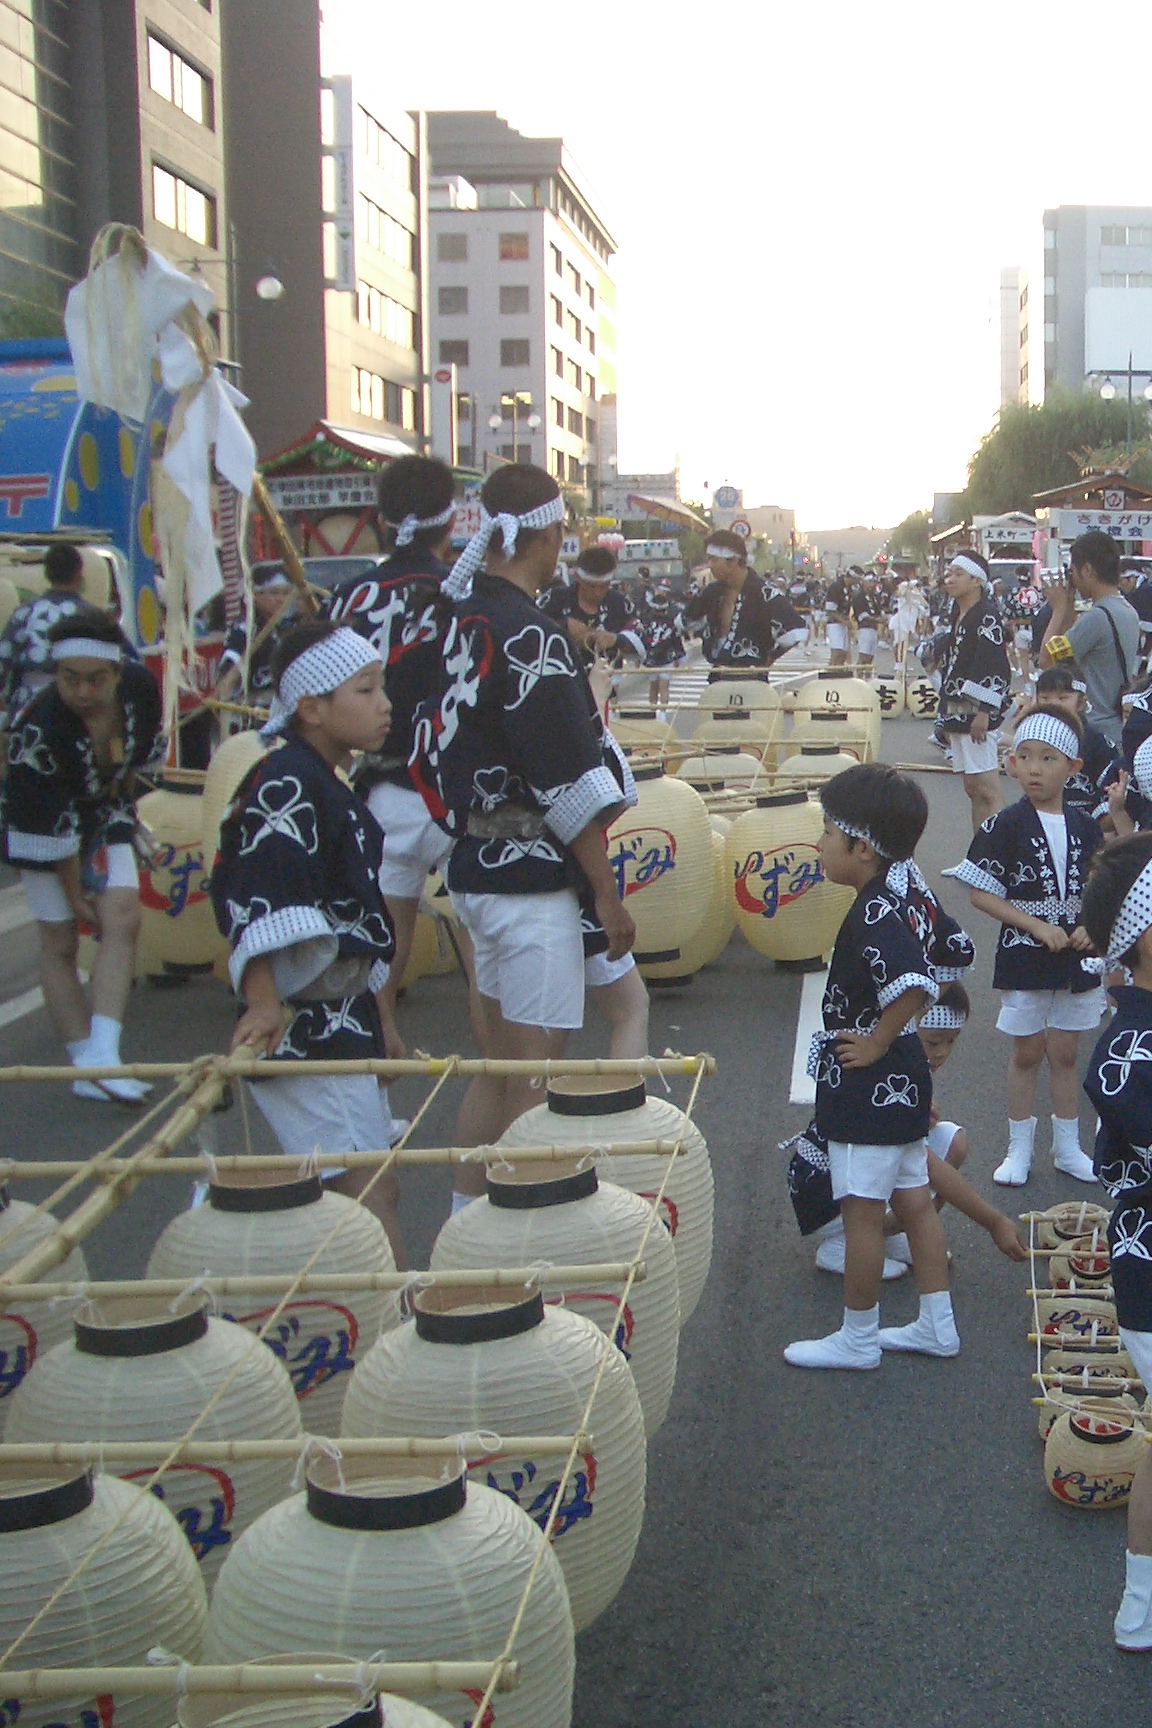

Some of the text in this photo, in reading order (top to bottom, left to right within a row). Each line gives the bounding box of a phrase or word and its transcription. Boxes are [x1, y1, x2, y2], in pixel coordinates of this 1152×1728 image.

[1076, 514, 1152, 526] さきがけ
[610, 837, 676, 902] ずみ
[734, 851, 827, 919] いずみ
